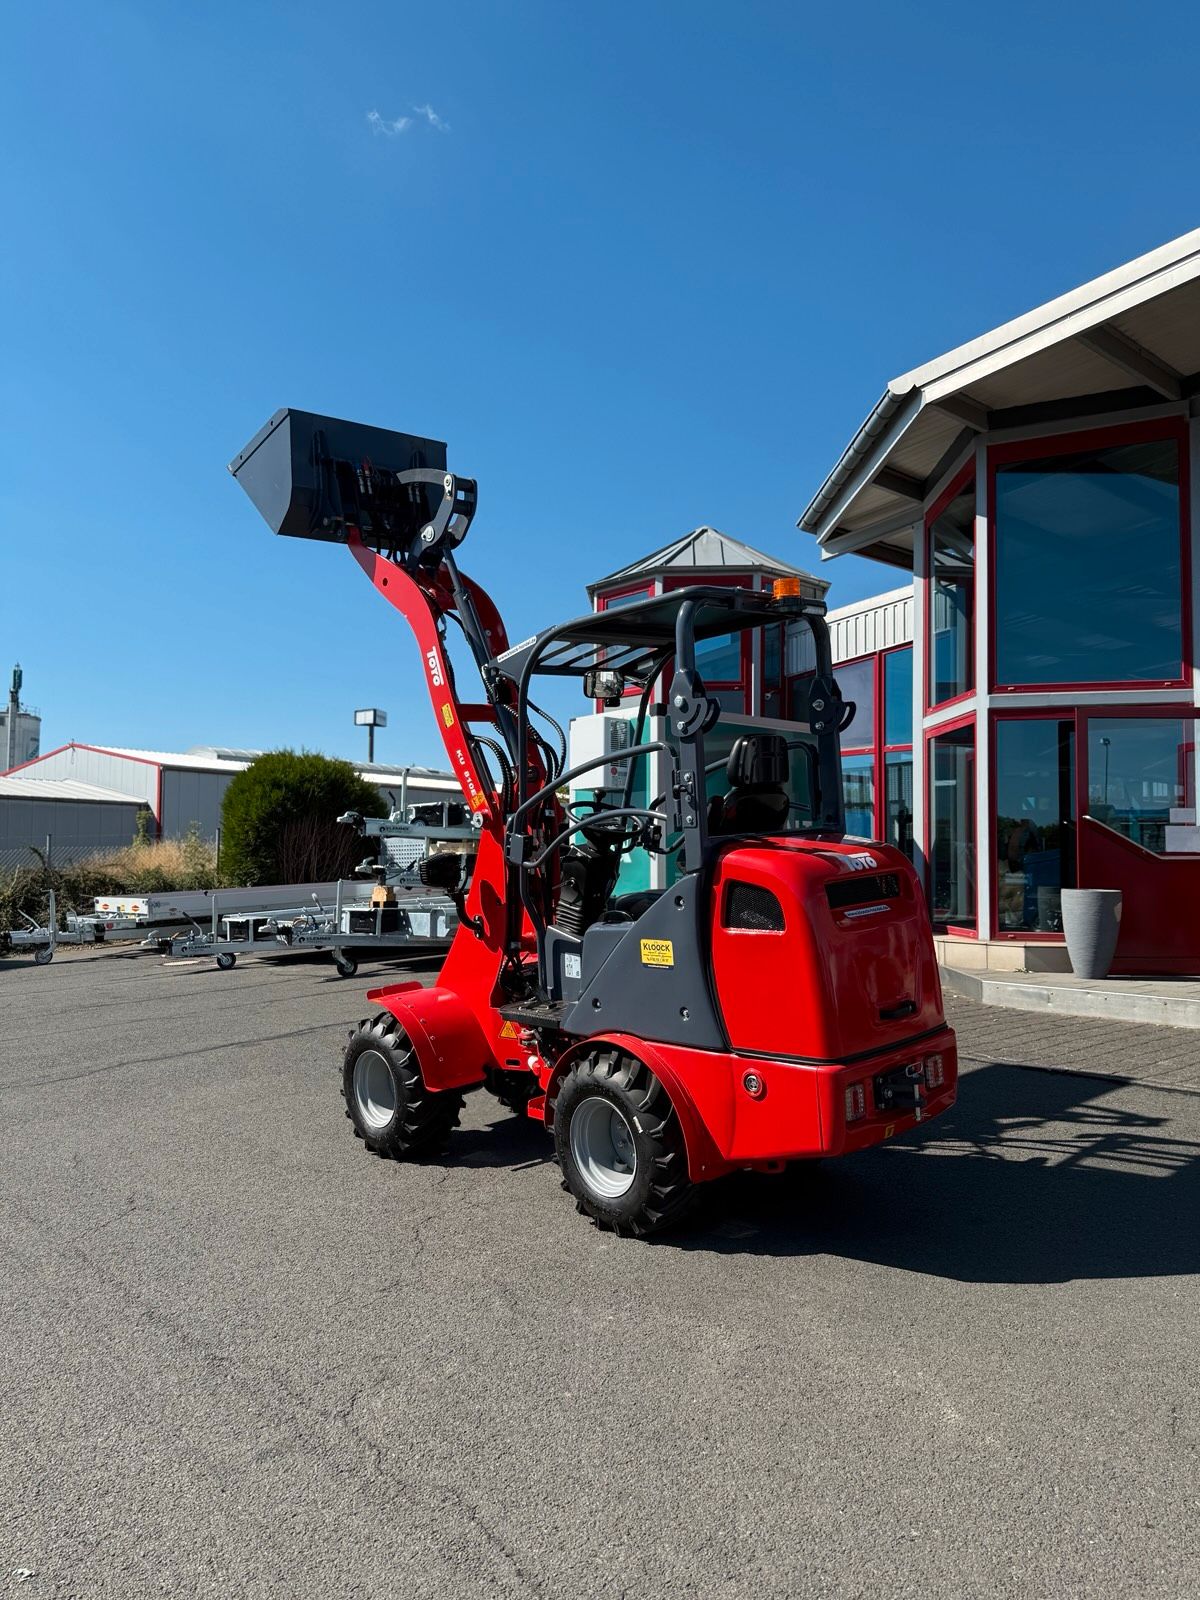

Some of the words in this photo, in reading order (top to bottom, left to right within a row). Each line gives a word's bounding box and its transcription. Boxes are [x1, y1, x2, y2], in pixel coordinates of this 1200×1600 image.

[426, 646, 444, 687] TOYO
[456, 749, 466, 765] KU
[844, 852, 877, 872] TOYO
[643, 943, 670, 952] KLOOCK
